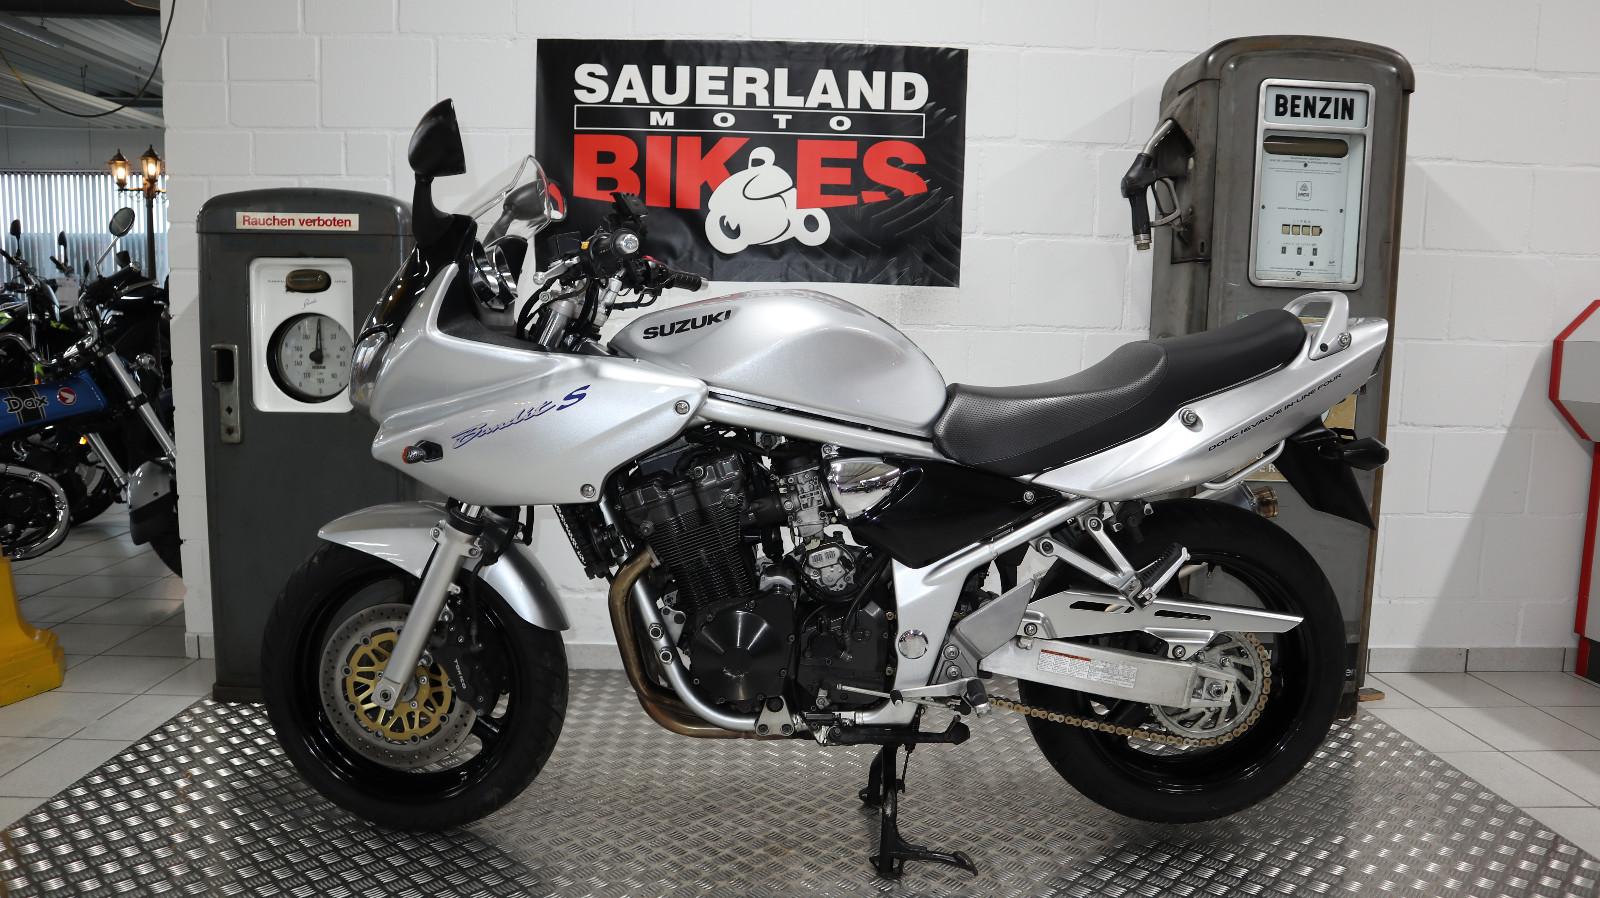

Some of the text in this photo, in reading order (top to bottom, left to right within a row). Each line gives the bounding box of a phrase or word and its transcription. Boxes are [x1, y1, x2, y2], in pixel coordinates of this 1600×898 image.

[573, 63, 929, 111] SAUERLAND
[649, 111, 852, 131] MOTO
[1274, 93, 1355, 121] BENZIN
[242, 215, 352, 228] Rauchen verboten
[642, 309, 732, 340] SUZUKI
[2, 395, 49, 414] Dax
[451, 384, 591, 450] Bandit S
[1208, 432, 1239, 452] DOHC
[1284, 388, 1317, 411] IN-LINE
[1317, 373, 1342, 391] FOUR
